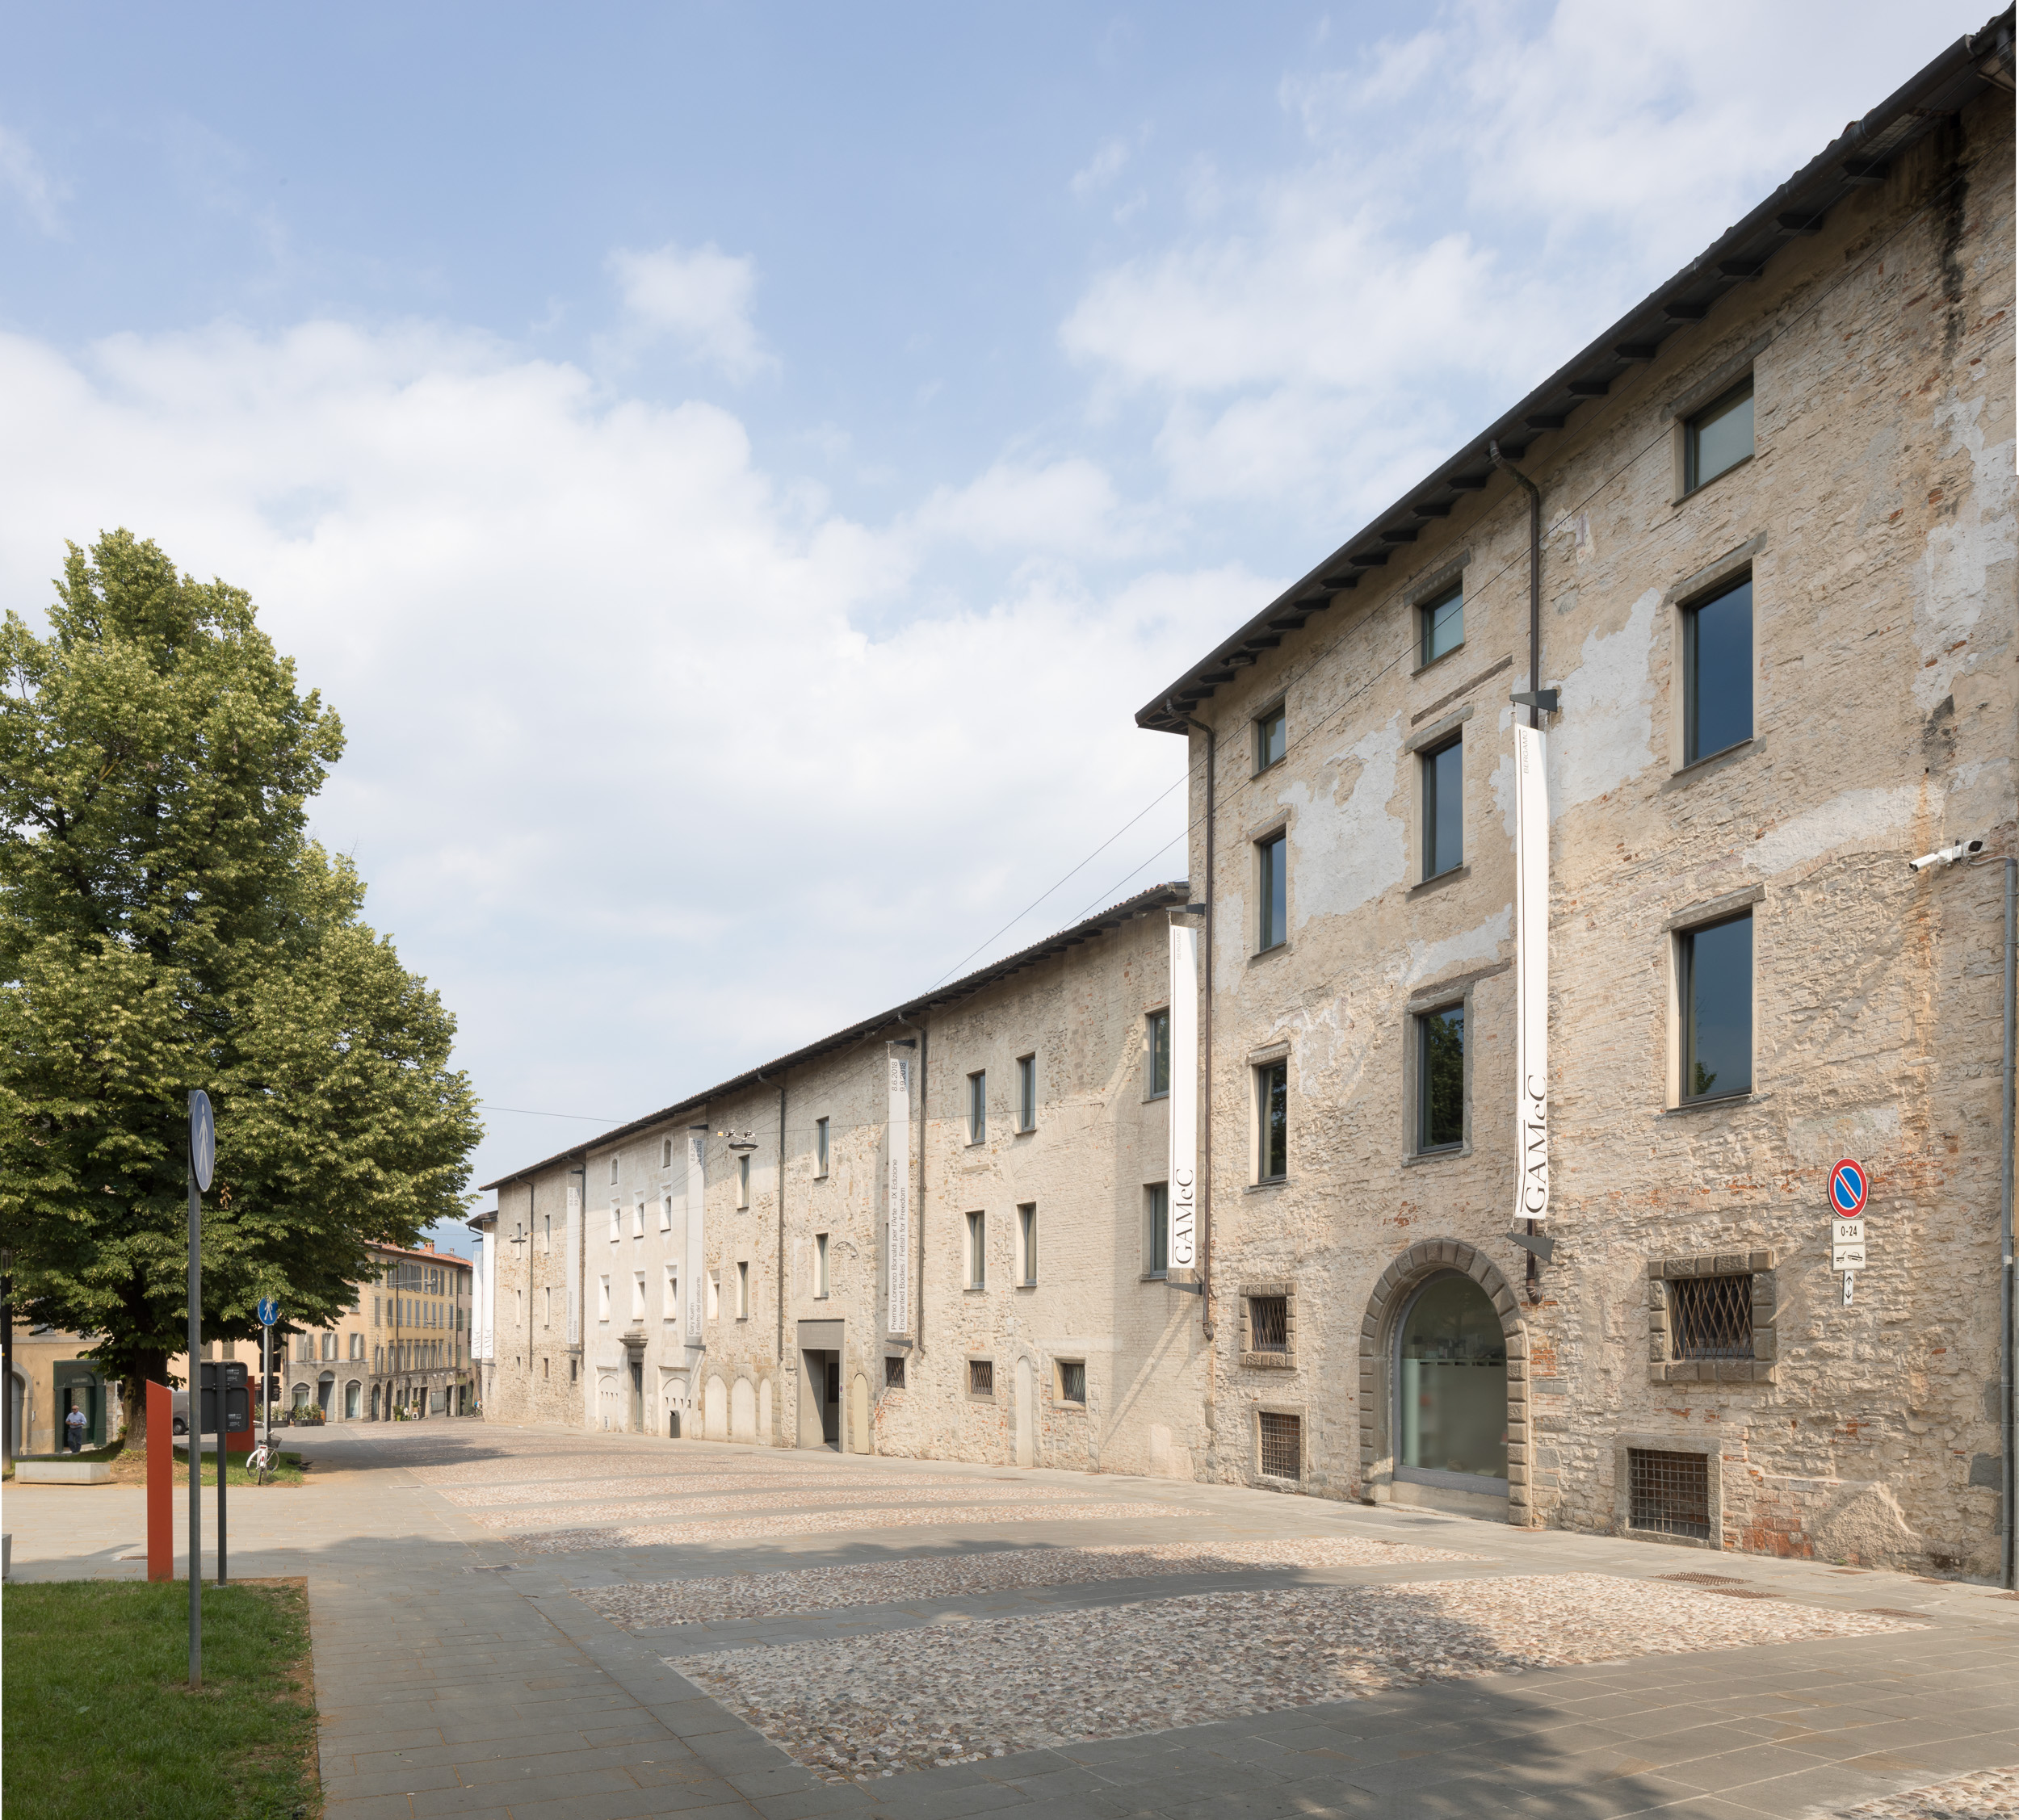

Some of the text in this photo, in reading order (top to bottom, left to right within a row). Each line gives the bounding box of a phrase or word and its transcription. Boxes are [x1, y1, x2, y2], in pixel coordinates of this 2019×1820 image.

[1525, 1075, 1546, 1214] GAMeC
[1175, 1168, 1193, 1264] GAMeC
[1841, 1226, 1857, 1236] 0-24
